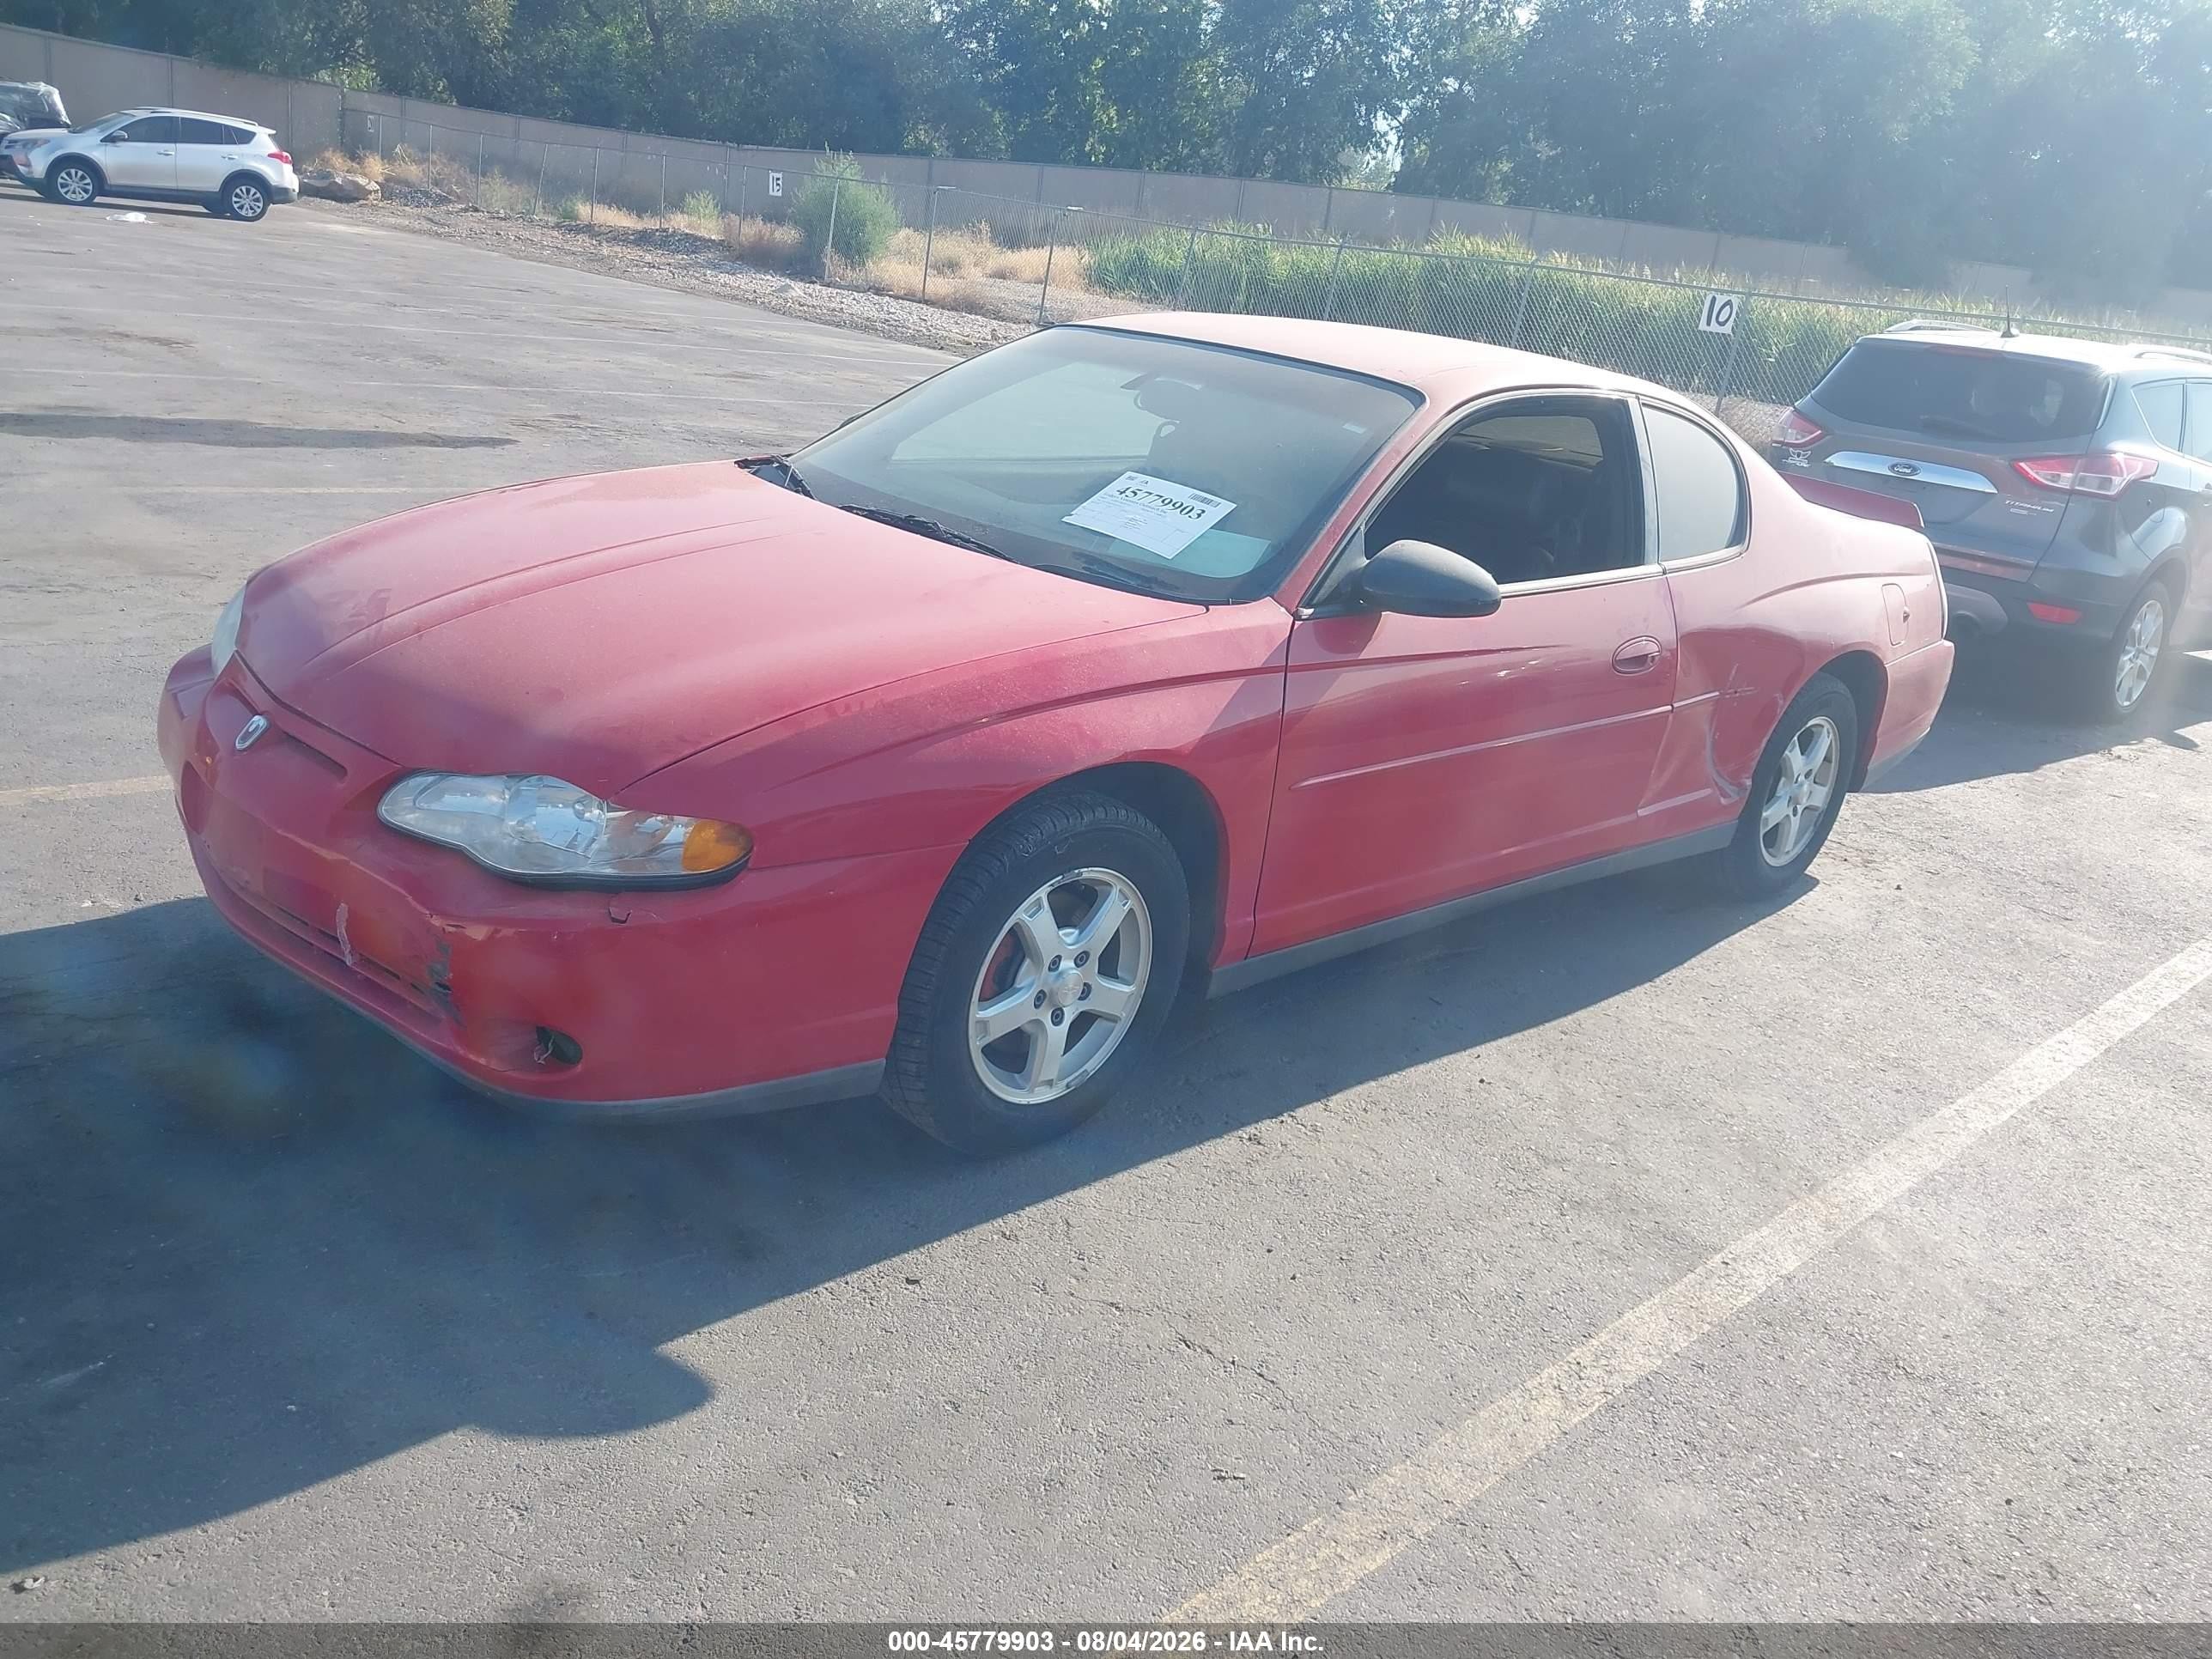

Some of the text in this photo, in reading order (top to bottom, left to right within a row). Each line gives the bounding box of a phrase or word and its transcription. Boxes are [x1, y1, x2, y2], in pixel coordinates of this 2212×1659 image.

[772, 175, 781, 192] 15
[1706, 295, 1734, 327] 10
[1893, 464, 1912, 473] Ford
[1116, 486, 1206, 520] 45779903
